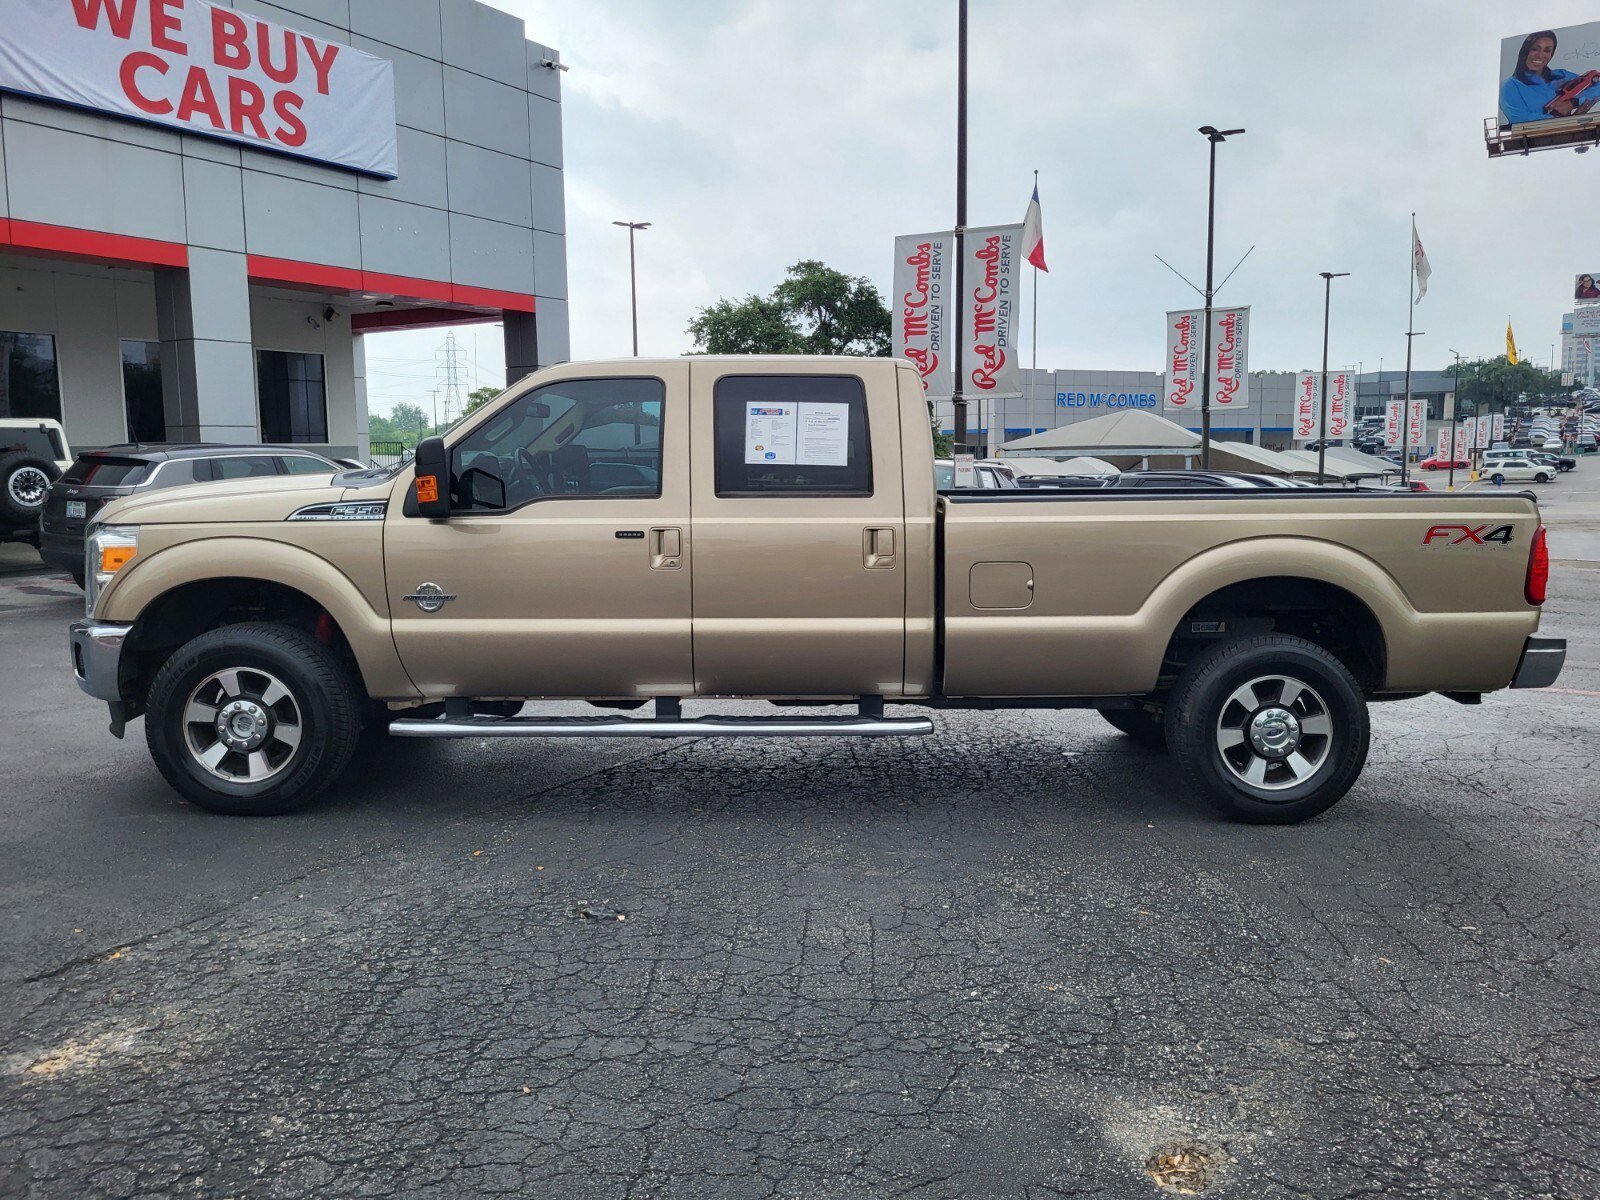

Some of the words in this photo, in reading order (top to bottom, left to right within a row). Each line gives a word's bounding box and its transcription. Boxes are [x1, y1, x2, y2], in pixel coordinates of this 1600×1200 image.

[71, 0, 188, 56] WE
[210, 7, 339, 95] BUY
[119, 51, 307, 147] CARS
[931, 242, 942, 280] SERVE
[1001, 234, 1011, 274] SERVE
[904, 242, 931, 344] McCombs
[931, 283, 941, 300] TO
[973, 235, 1000, 341] McCombs
[1000, 278, 1009, 295] TO
[931, 304, 940, 351] DRIVEN
[998, 300, 1009, 347] DRIVEN
[1173, 315, 1190, 376] McCombs
[1217, 313, 1235, 374] McCombs
[971, 344, 1006, 389] Red
[1057, 392, 1086, 407] RED
[1170, 378, 1194, 404] Red
[1216, 376, 1240, 403] Red
[1422, 524, 1516, 546] FX4
